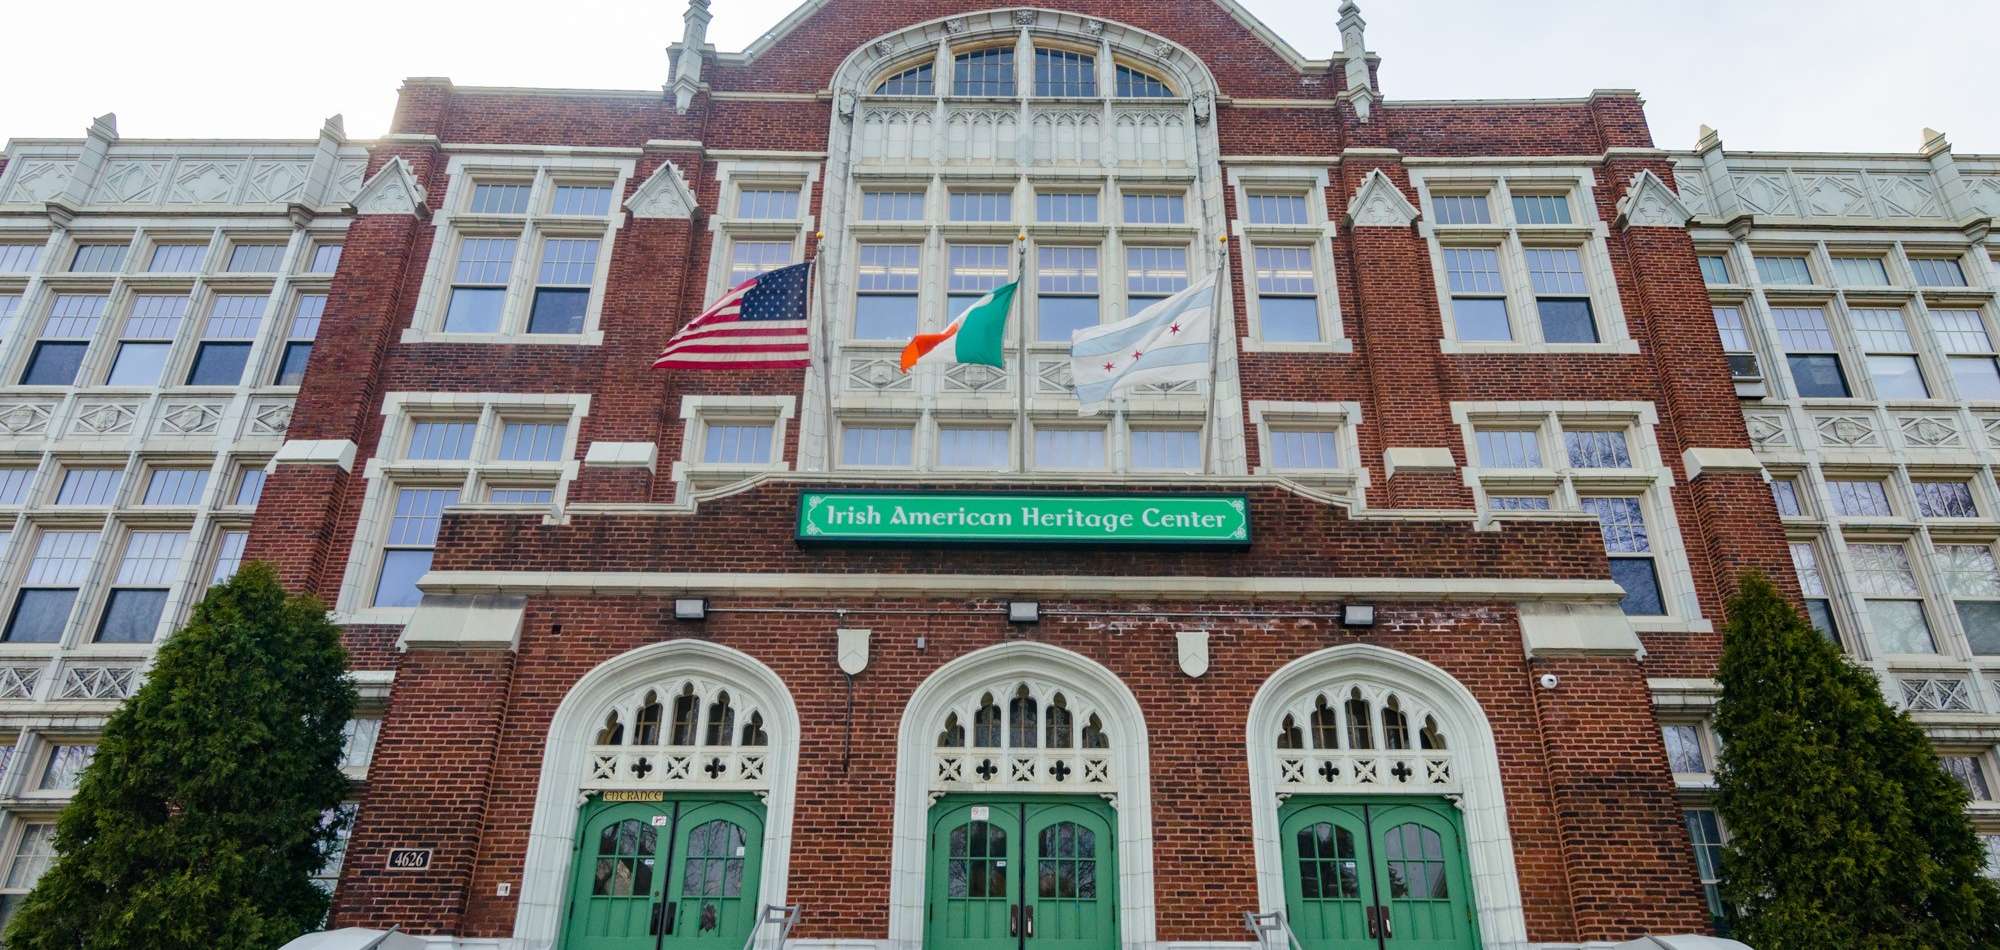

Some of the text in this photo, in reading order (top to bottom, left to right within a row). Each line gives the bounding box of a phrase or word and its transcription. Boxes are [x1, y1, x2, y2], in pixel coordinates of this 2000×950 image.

[826, 504, 1227, 532] Irish American Heritage Center
[394, 851, 425, 867] 4626
